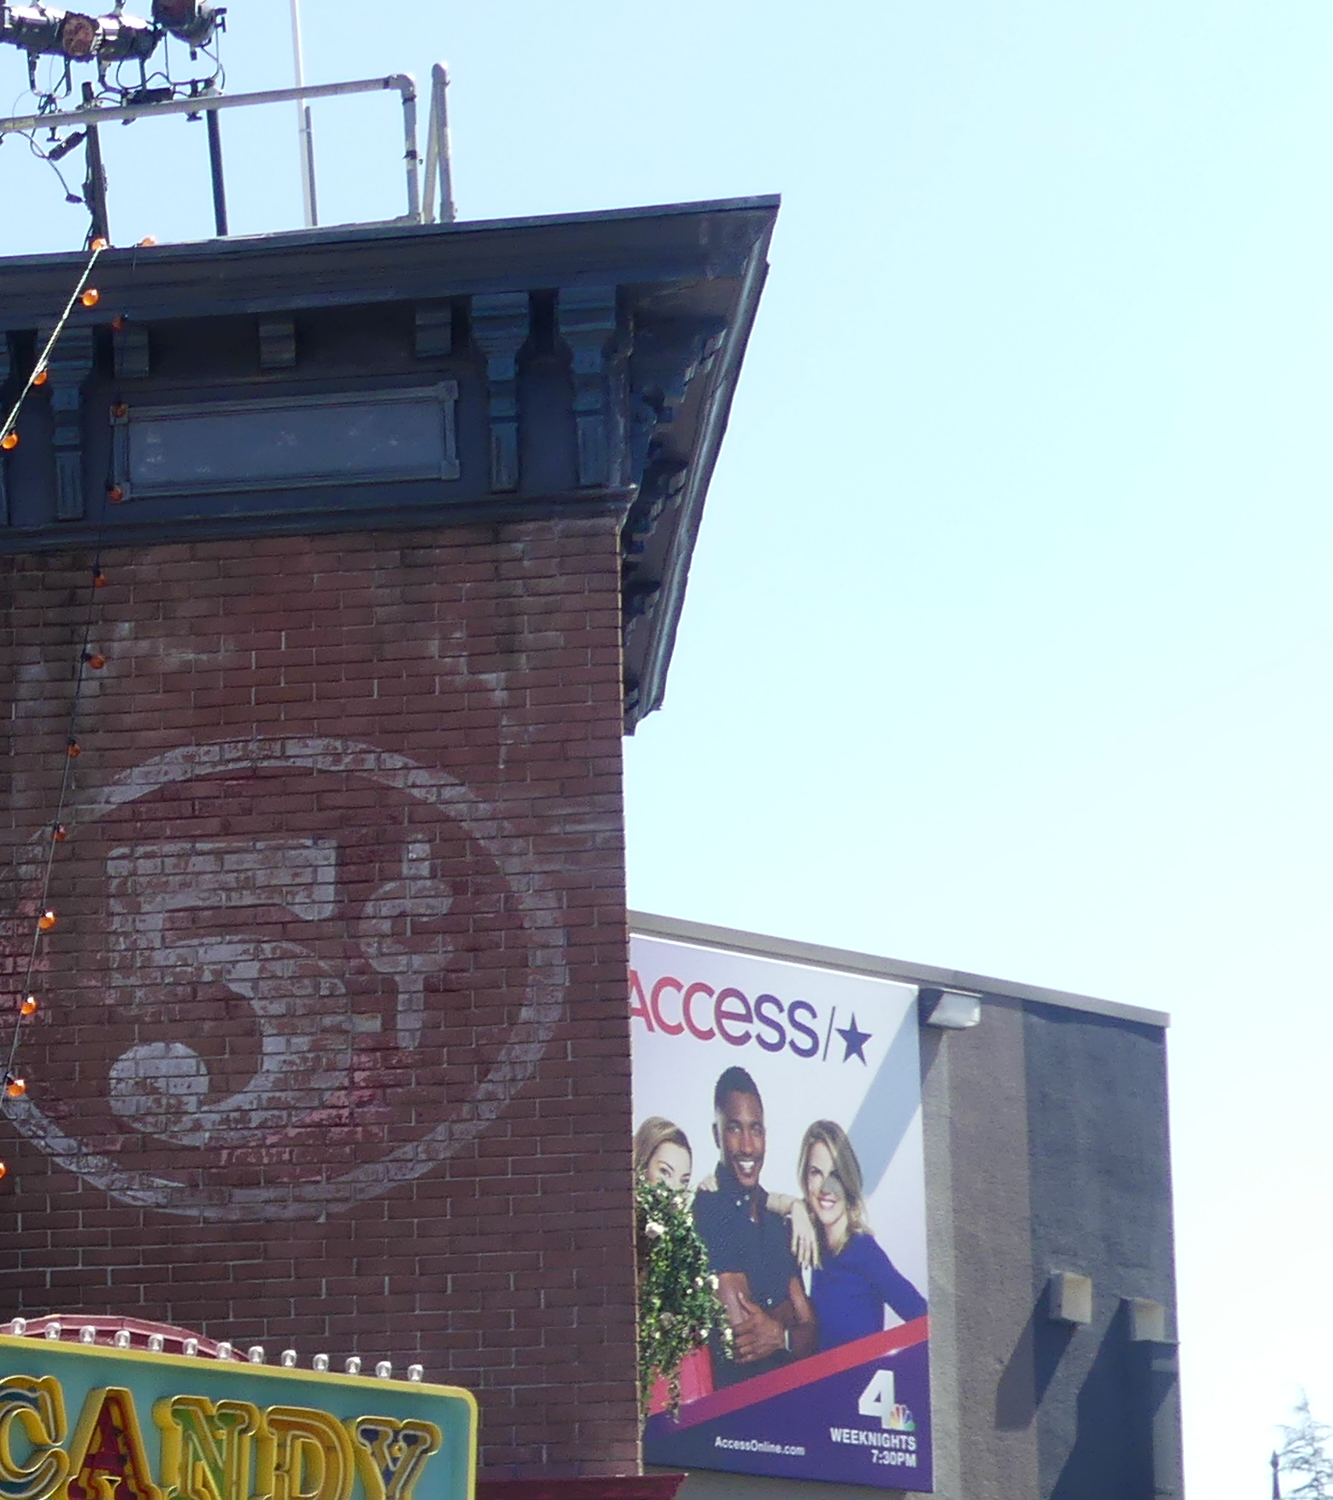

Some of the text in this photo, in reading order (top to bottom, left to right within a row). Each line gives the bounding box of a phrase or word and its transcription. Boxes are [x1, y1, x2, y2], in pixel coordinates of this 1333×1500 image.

[857, 1369, 899, 1430] 4
[714, 1435, 806, 1456] AccessOnline.com
[830, 1427, 917, 1450] WEEKNIGHTS
[871, 1448, 917, 1468] 7:30PM
